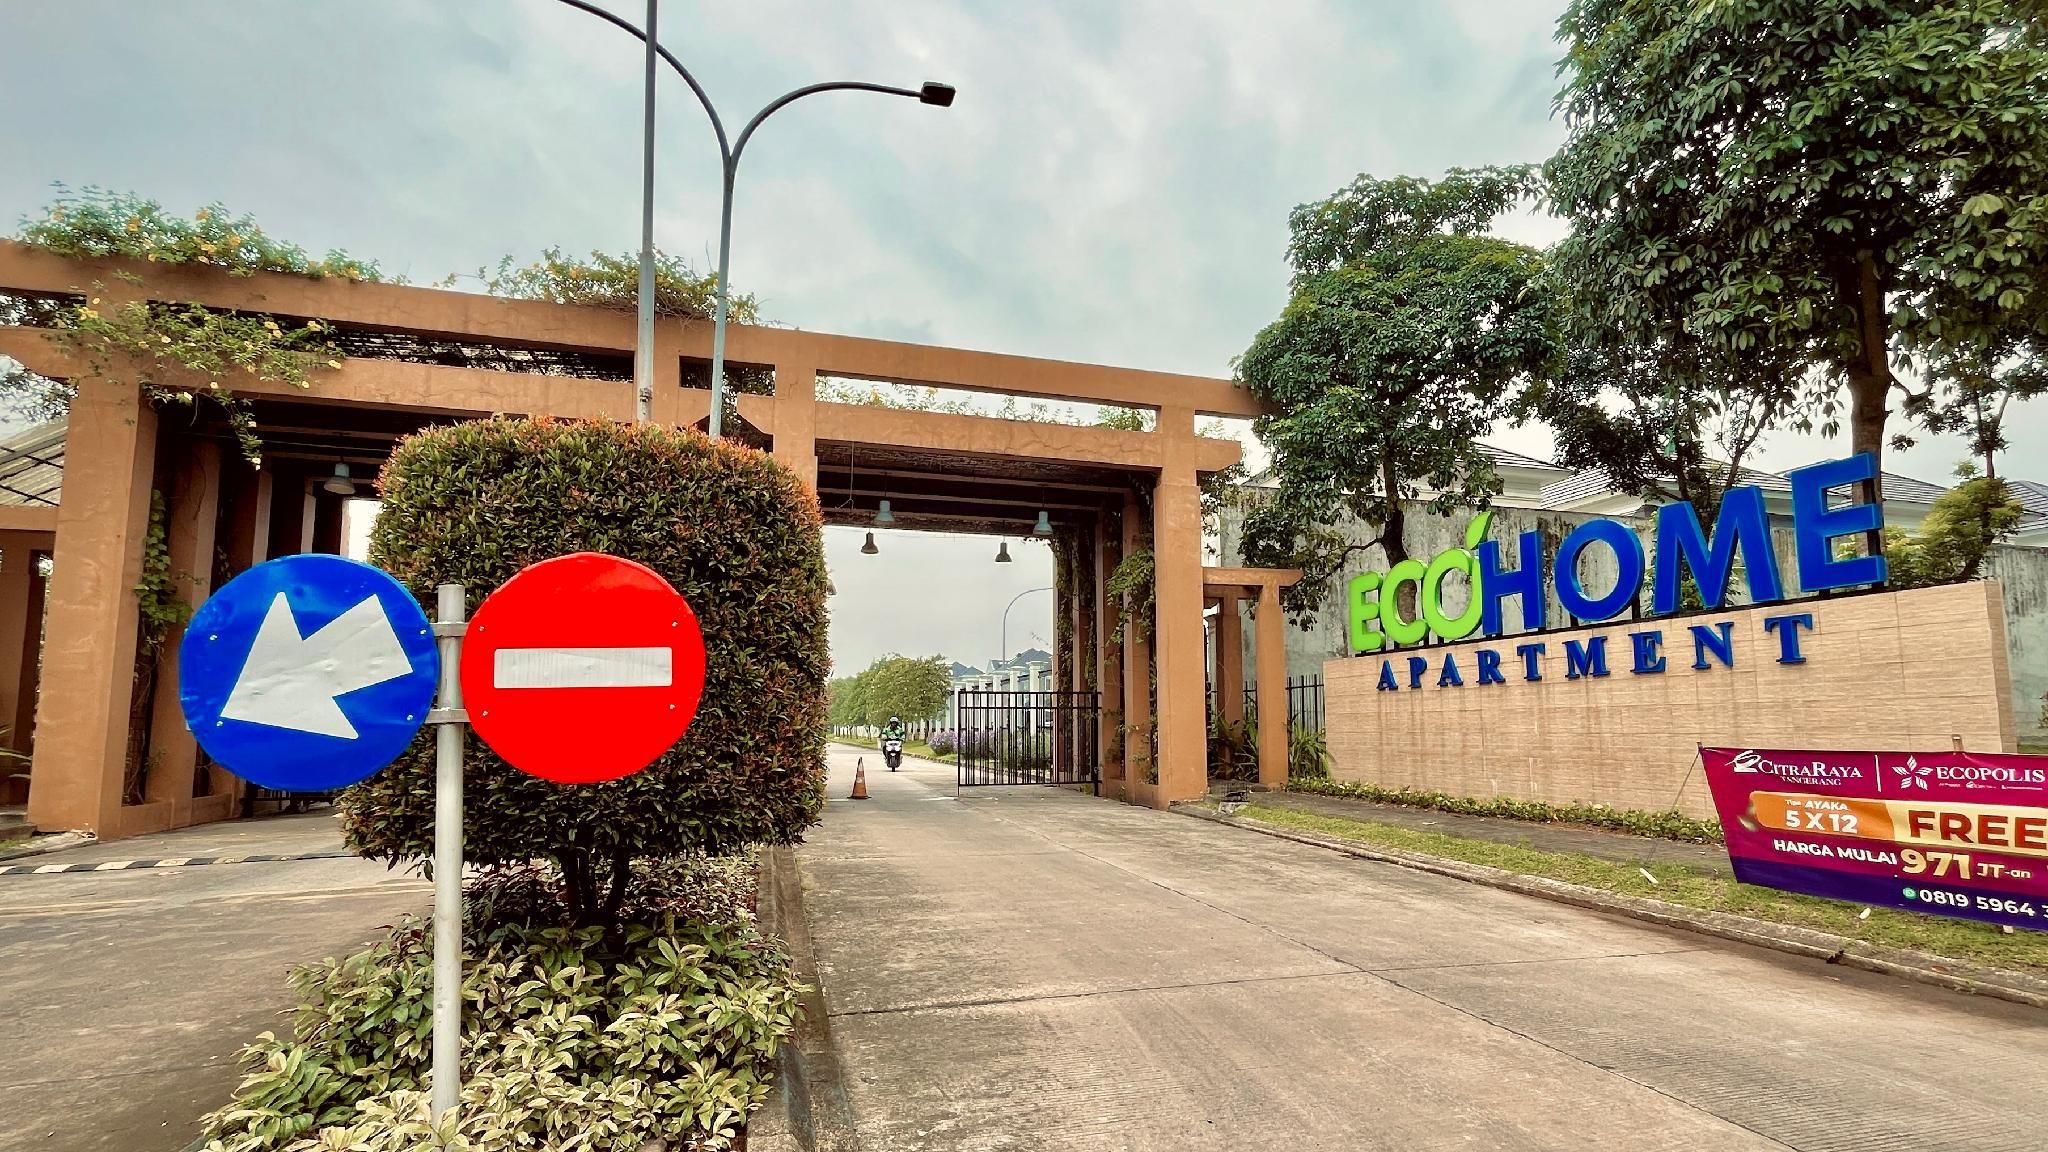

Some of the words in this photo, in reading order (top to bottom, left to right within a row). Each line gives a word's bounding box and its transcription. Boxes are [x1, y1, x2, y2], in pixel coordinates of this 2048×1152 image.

[1376, 613, 1813, 692] APARTMENT
[1780, 775, 1842, 786] TANGERANG
[1936, 766, 2046, 783] ECOPOLIS
[1805, 800, 1849, 811] AYAKA
[1785, 810, 1801, 828] 5
[1828, 813, 1858, 834] 12
[1908, 810, 2048, 850] FREE
[1773, 839, 1835, 857] HARGA
[1836, 846, 1898, 865] MULAI
[1900, 848, 1971, 880] 971
[1919, 889, 1970, 908] 0819
[1976, 896, 2036, 917] 5964
